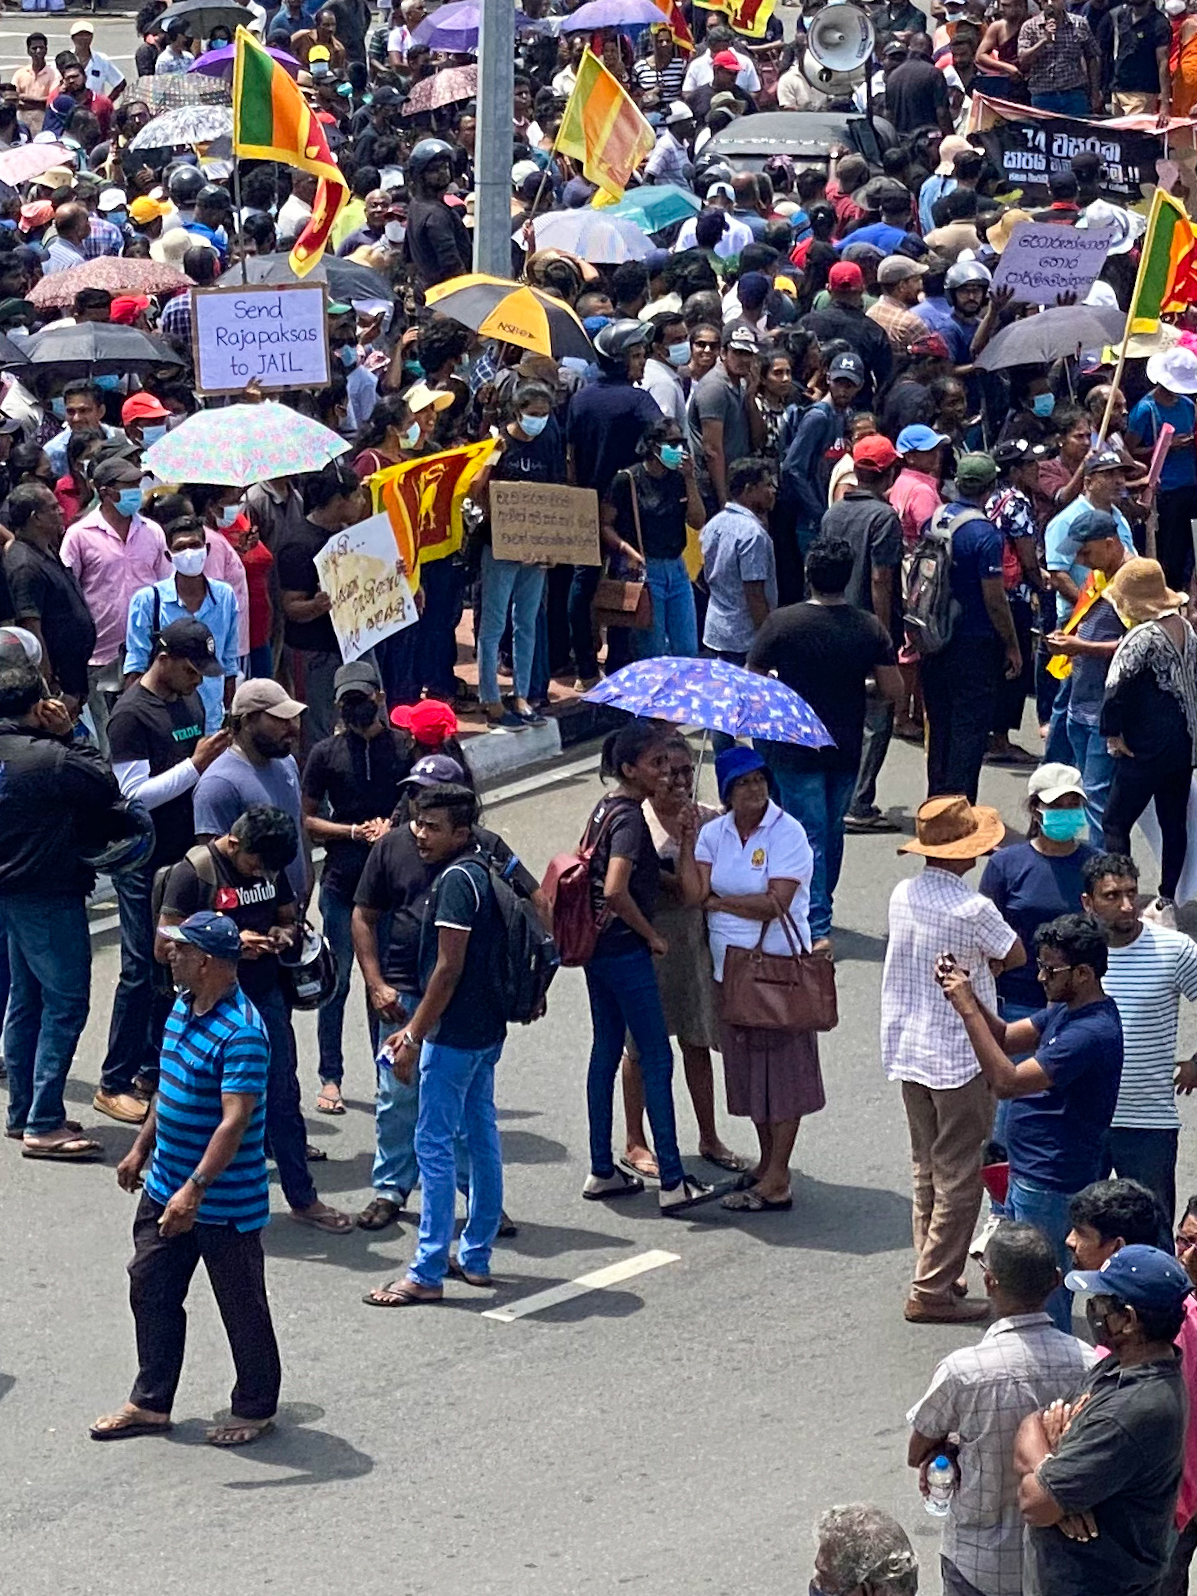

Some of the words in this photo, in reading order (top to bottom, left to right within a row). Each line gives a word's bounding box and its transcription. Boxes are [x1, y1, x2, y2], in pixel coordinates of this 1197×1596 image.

[234, 296, 283, 319] Send
[215, 323, 318, 351] Rajapaksas
[230, 355, 249, 376] to
[256, 351, 303, 375] JAIL
[235, 880, 277, 906] YouTub
